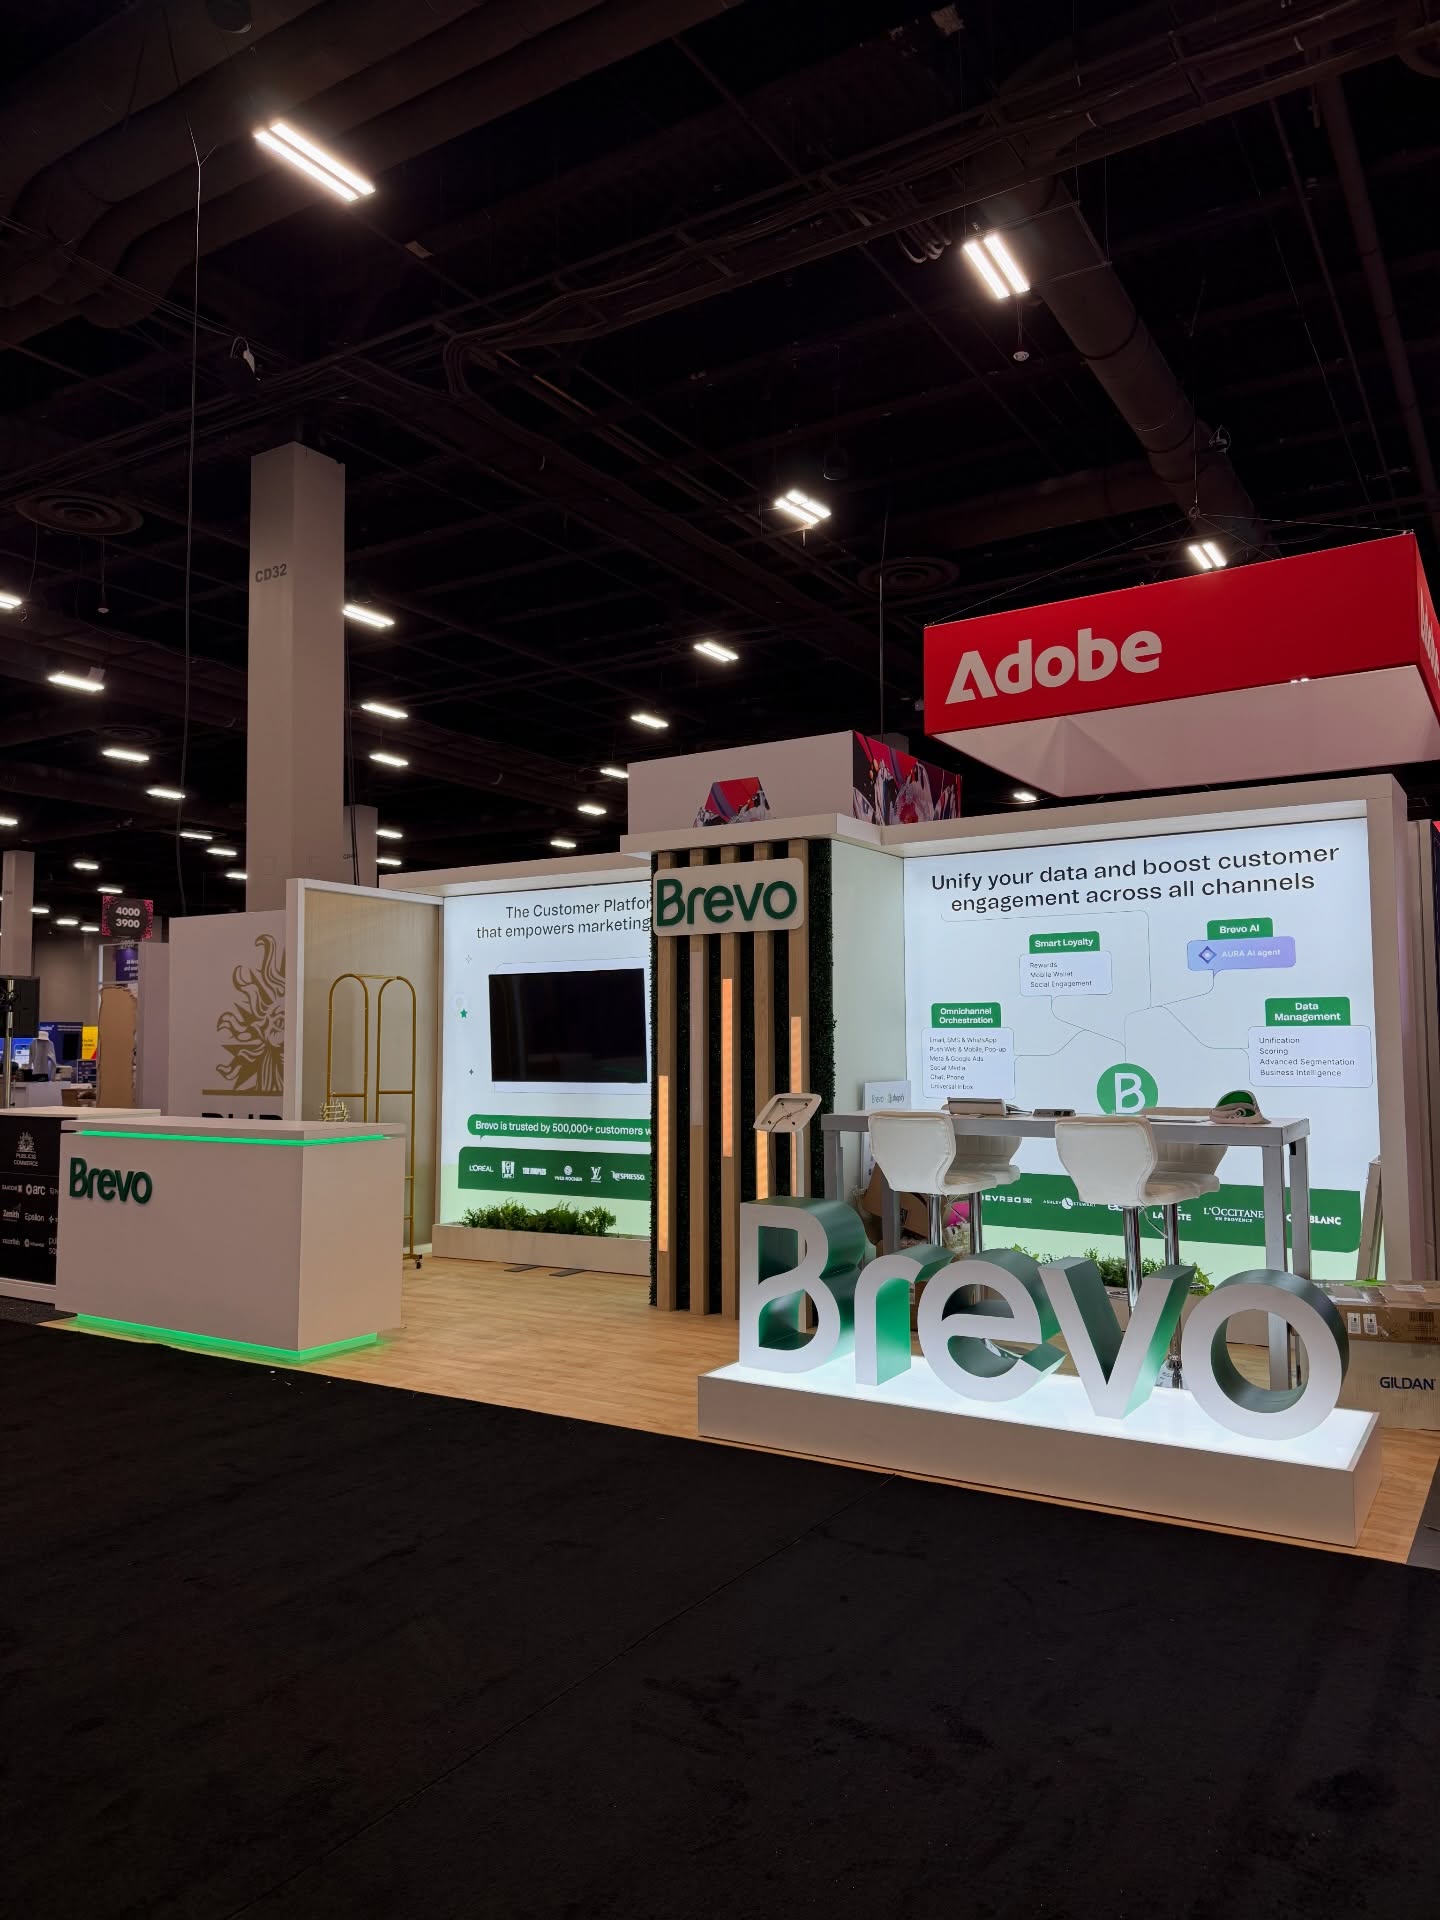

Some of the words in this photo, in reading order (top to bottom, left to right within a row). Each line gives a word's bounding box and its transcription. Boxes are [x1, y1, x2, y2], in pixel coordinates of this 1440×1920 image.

[256, 563, 287, 583] CD32
[945, 628, 1162, 704] Adobe
[932, 873, 982, 892] Unify
[988, 871, 1033, 891] your
[1040, 867, 1088, 883] data
[1094, 860, 1136, 879] and
[1144, 855, 1211, 875] boost
[1218, 847, 1340, 870] customer
[951, 889, 1080, 914] engagement
[1087, 885, 1162, 904] across
[1169, 880, 1194, 898] all
[1202, 873, 1315, 895] channels
[506, 907, 530, 918] The
[533, 903, 600, 917] Customer
[604, 897, 651, 912] Platfor
[656, 878, 797, 927] Brevo
[116, 907, 140, 916] 4000
[116, 919, 140, 928] 3900
[477, 927, 502, 938] that
[506, 923, 574, 938] empowers
[579, 917, 651, 935] marketing
[1219, 925, 1247, 934] Brevo
[1250, 924, 1260, 933] AI
[1035, 939, 1061, 949] Smart
[1063, 938, 1094, 948] Loyalty
[1221, 950, 1245, 958] AURA
[1257, 948, 1281, 959] agent
[1029, 961, 1058, 969] Rewards
[1051, 980, 1092, 989] Engagement
[1295, 1003, 1319, 1011] Data
[1274, 1013, 1341, 1022] Management
[1259, 1047, 1288, 1056] Scoring
[950, 1055, 971, 1063] Google
[1300, 1058, 1355, 1067] Segmentation
[1296, 1069, 1341, 1078] Intelligence
[1115, 1072, 1145, 1113] B
[475, 1120, 499, 1131] Brevo
[500, 1120, 508, 1131] is
[508, 1122, 539, 1132] trusted
[540, 1122, 551, 1135] by
[552, 1123, 593, 1135] 500,000+
[595, 1126, 644, 1136] customers
[70, 1157, 152, 1204] Brevo
[33, 1185, 46, 1196] arc
[25, 1212, 45, 1222] Epsilon
[1203, 1206, 1265, 1219] L'OCCITANE
[740, 1198, 1349, 1441] Brevo
[1379, 1376, 1434, 1391] GILDAN
